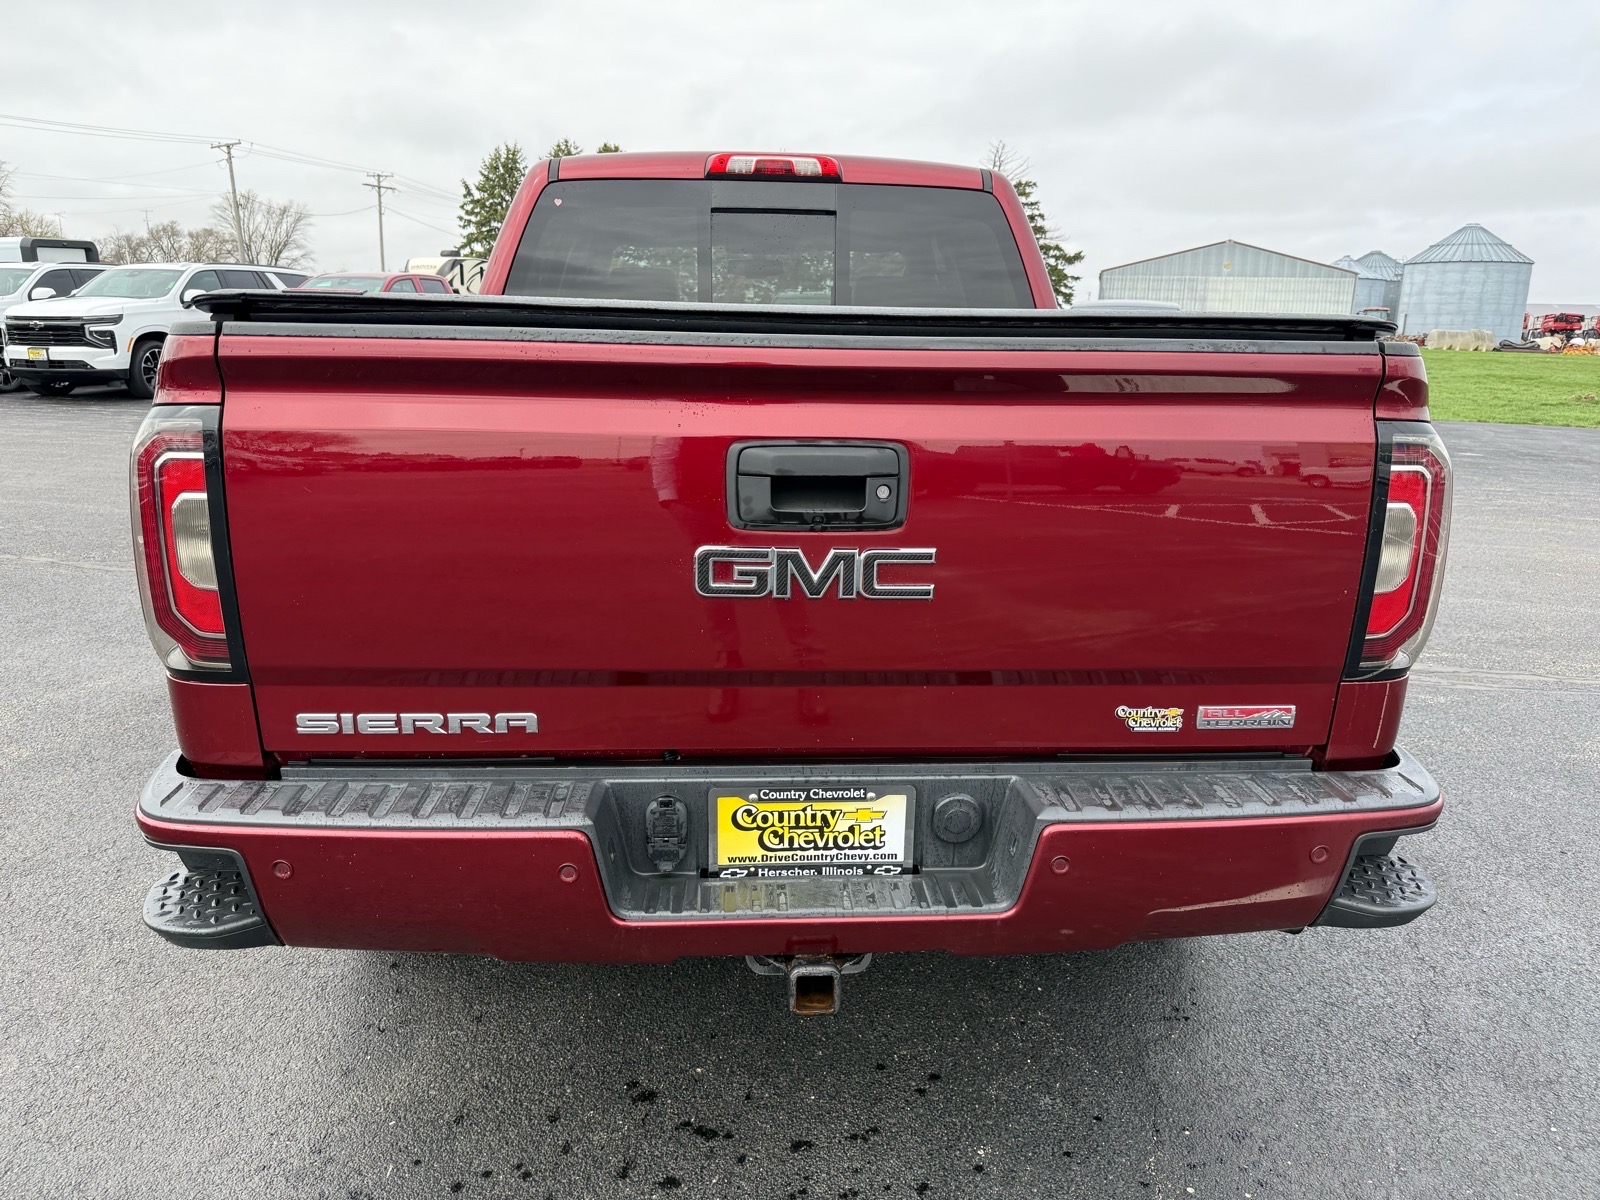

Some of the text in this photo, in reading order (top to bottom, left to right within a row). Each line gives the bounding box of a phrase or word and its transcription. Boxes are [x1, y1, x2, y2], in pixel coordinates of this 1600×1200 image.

[695, 546, 936, 600] GMC
[1115, 705, 1163, 719] Country
[1207, 709, 1246, 717] ALL
[296, 712, 539, 735] SIERRA
[1126, 716, 1182, 728] Chevrolet
[1202, 719, 1291, 727] TERRAIN
[760, 788, 865, 801] Country Chevrolet
[732, 804, 843, 832] Country
[758, 824, 886, 852] Chevrolet
[727, 852, 898, 863] www.DriveCountryChevy.com
[822, 866, 864, 876] Illinois
